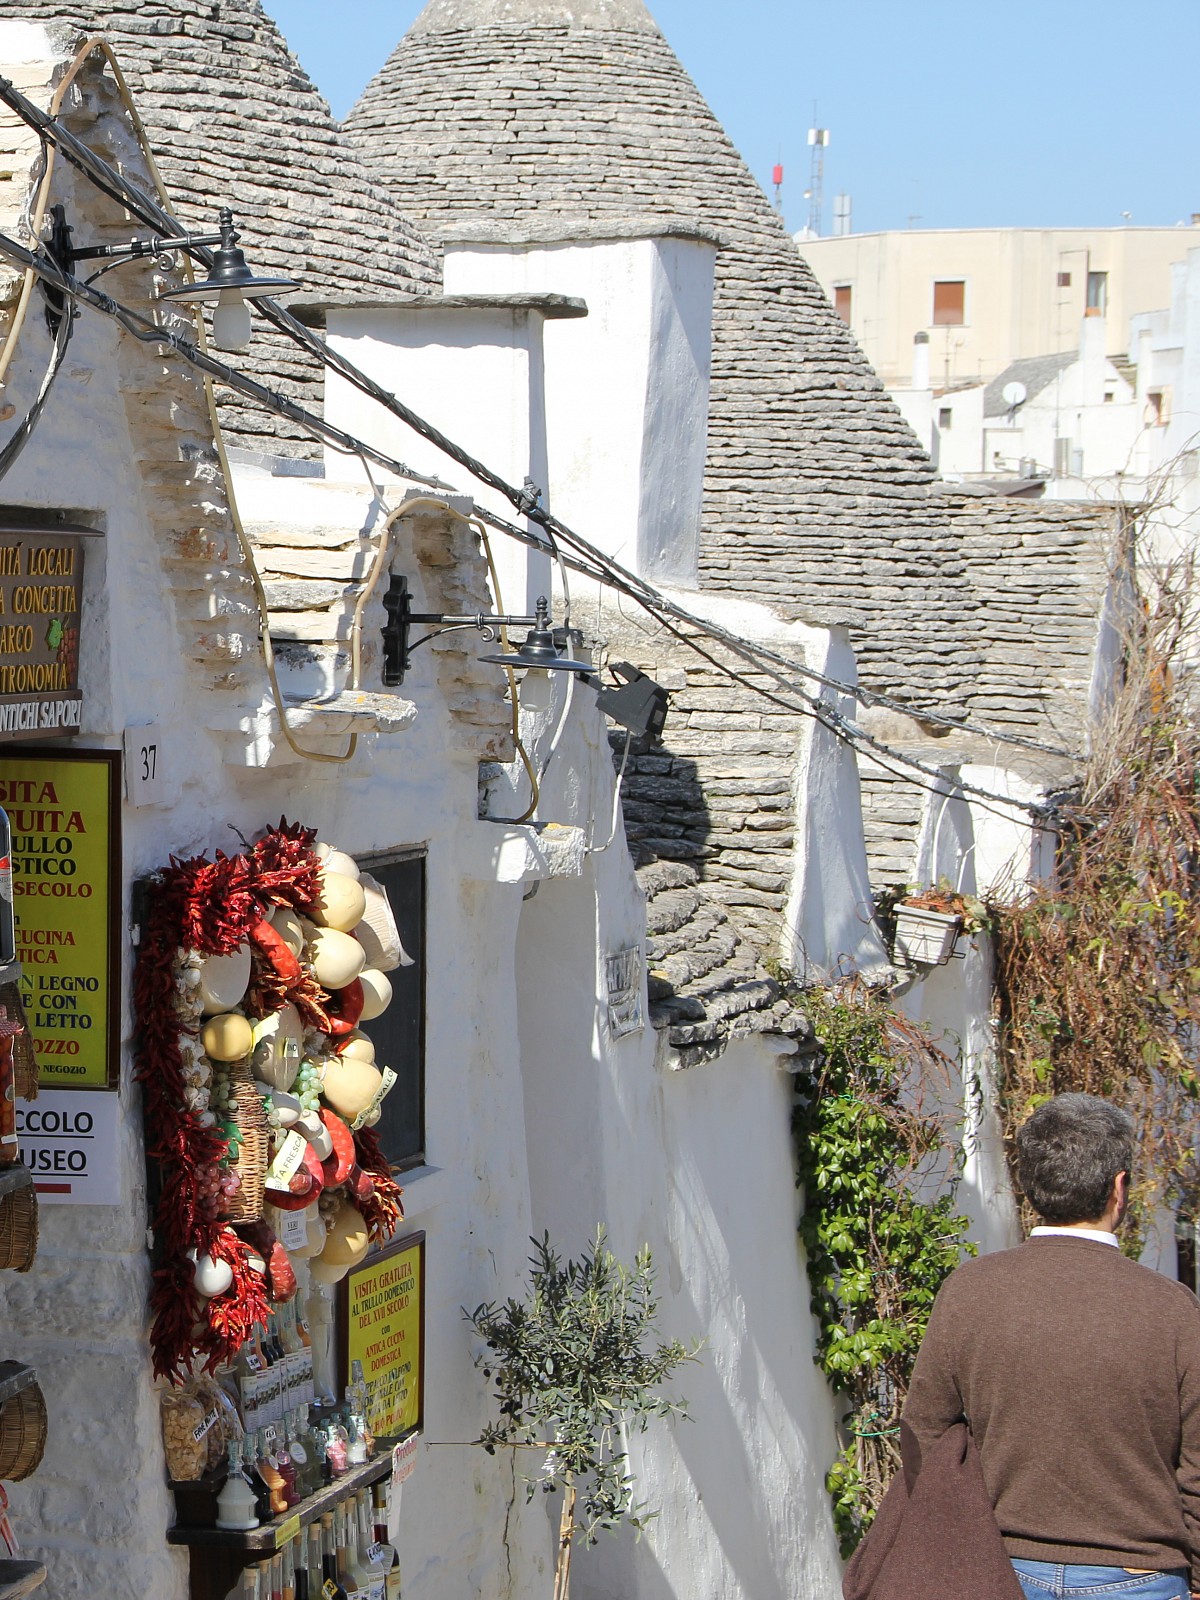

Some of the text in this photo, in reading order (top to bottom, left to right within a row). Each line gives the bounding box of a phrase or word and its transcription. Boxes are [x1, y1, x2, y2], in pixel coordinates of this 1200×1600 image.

[29, 547, 75, 576] LOCALI
[13, 584, 77, 614] CONCETTA
[40, 699, 82, 730] SAPORI
[141, 744, 157, 781] 37
[13, 881, 93, 898] SECOLO
[14, 930, 76, 946] CUCINA
[39, 976, 99, 991] LEGNO
[39, 994, 77, 1010] CON
[35, 1013, 92, 1029] LETTO
[43, 1065, 87, 1075] NEGOZIO
[16, 1111, 94, 1133] CCOLO
[20, 1149, 87, 1171] USEO
[354, 1261, 412, 1300] VISITA GRATUITA
[352, 1277, 415, 1317] AL TRULLO DOMESTICO
[359, 1313, 371, 1329] DEL
[387, 1294, 410, 1316] SECOLO
[381, 1325, 391, 1335] con
[365, 1329, 405, 1359] ANTICA CUCINA
[371, 1347, 402, 1372] DOMESTICA
